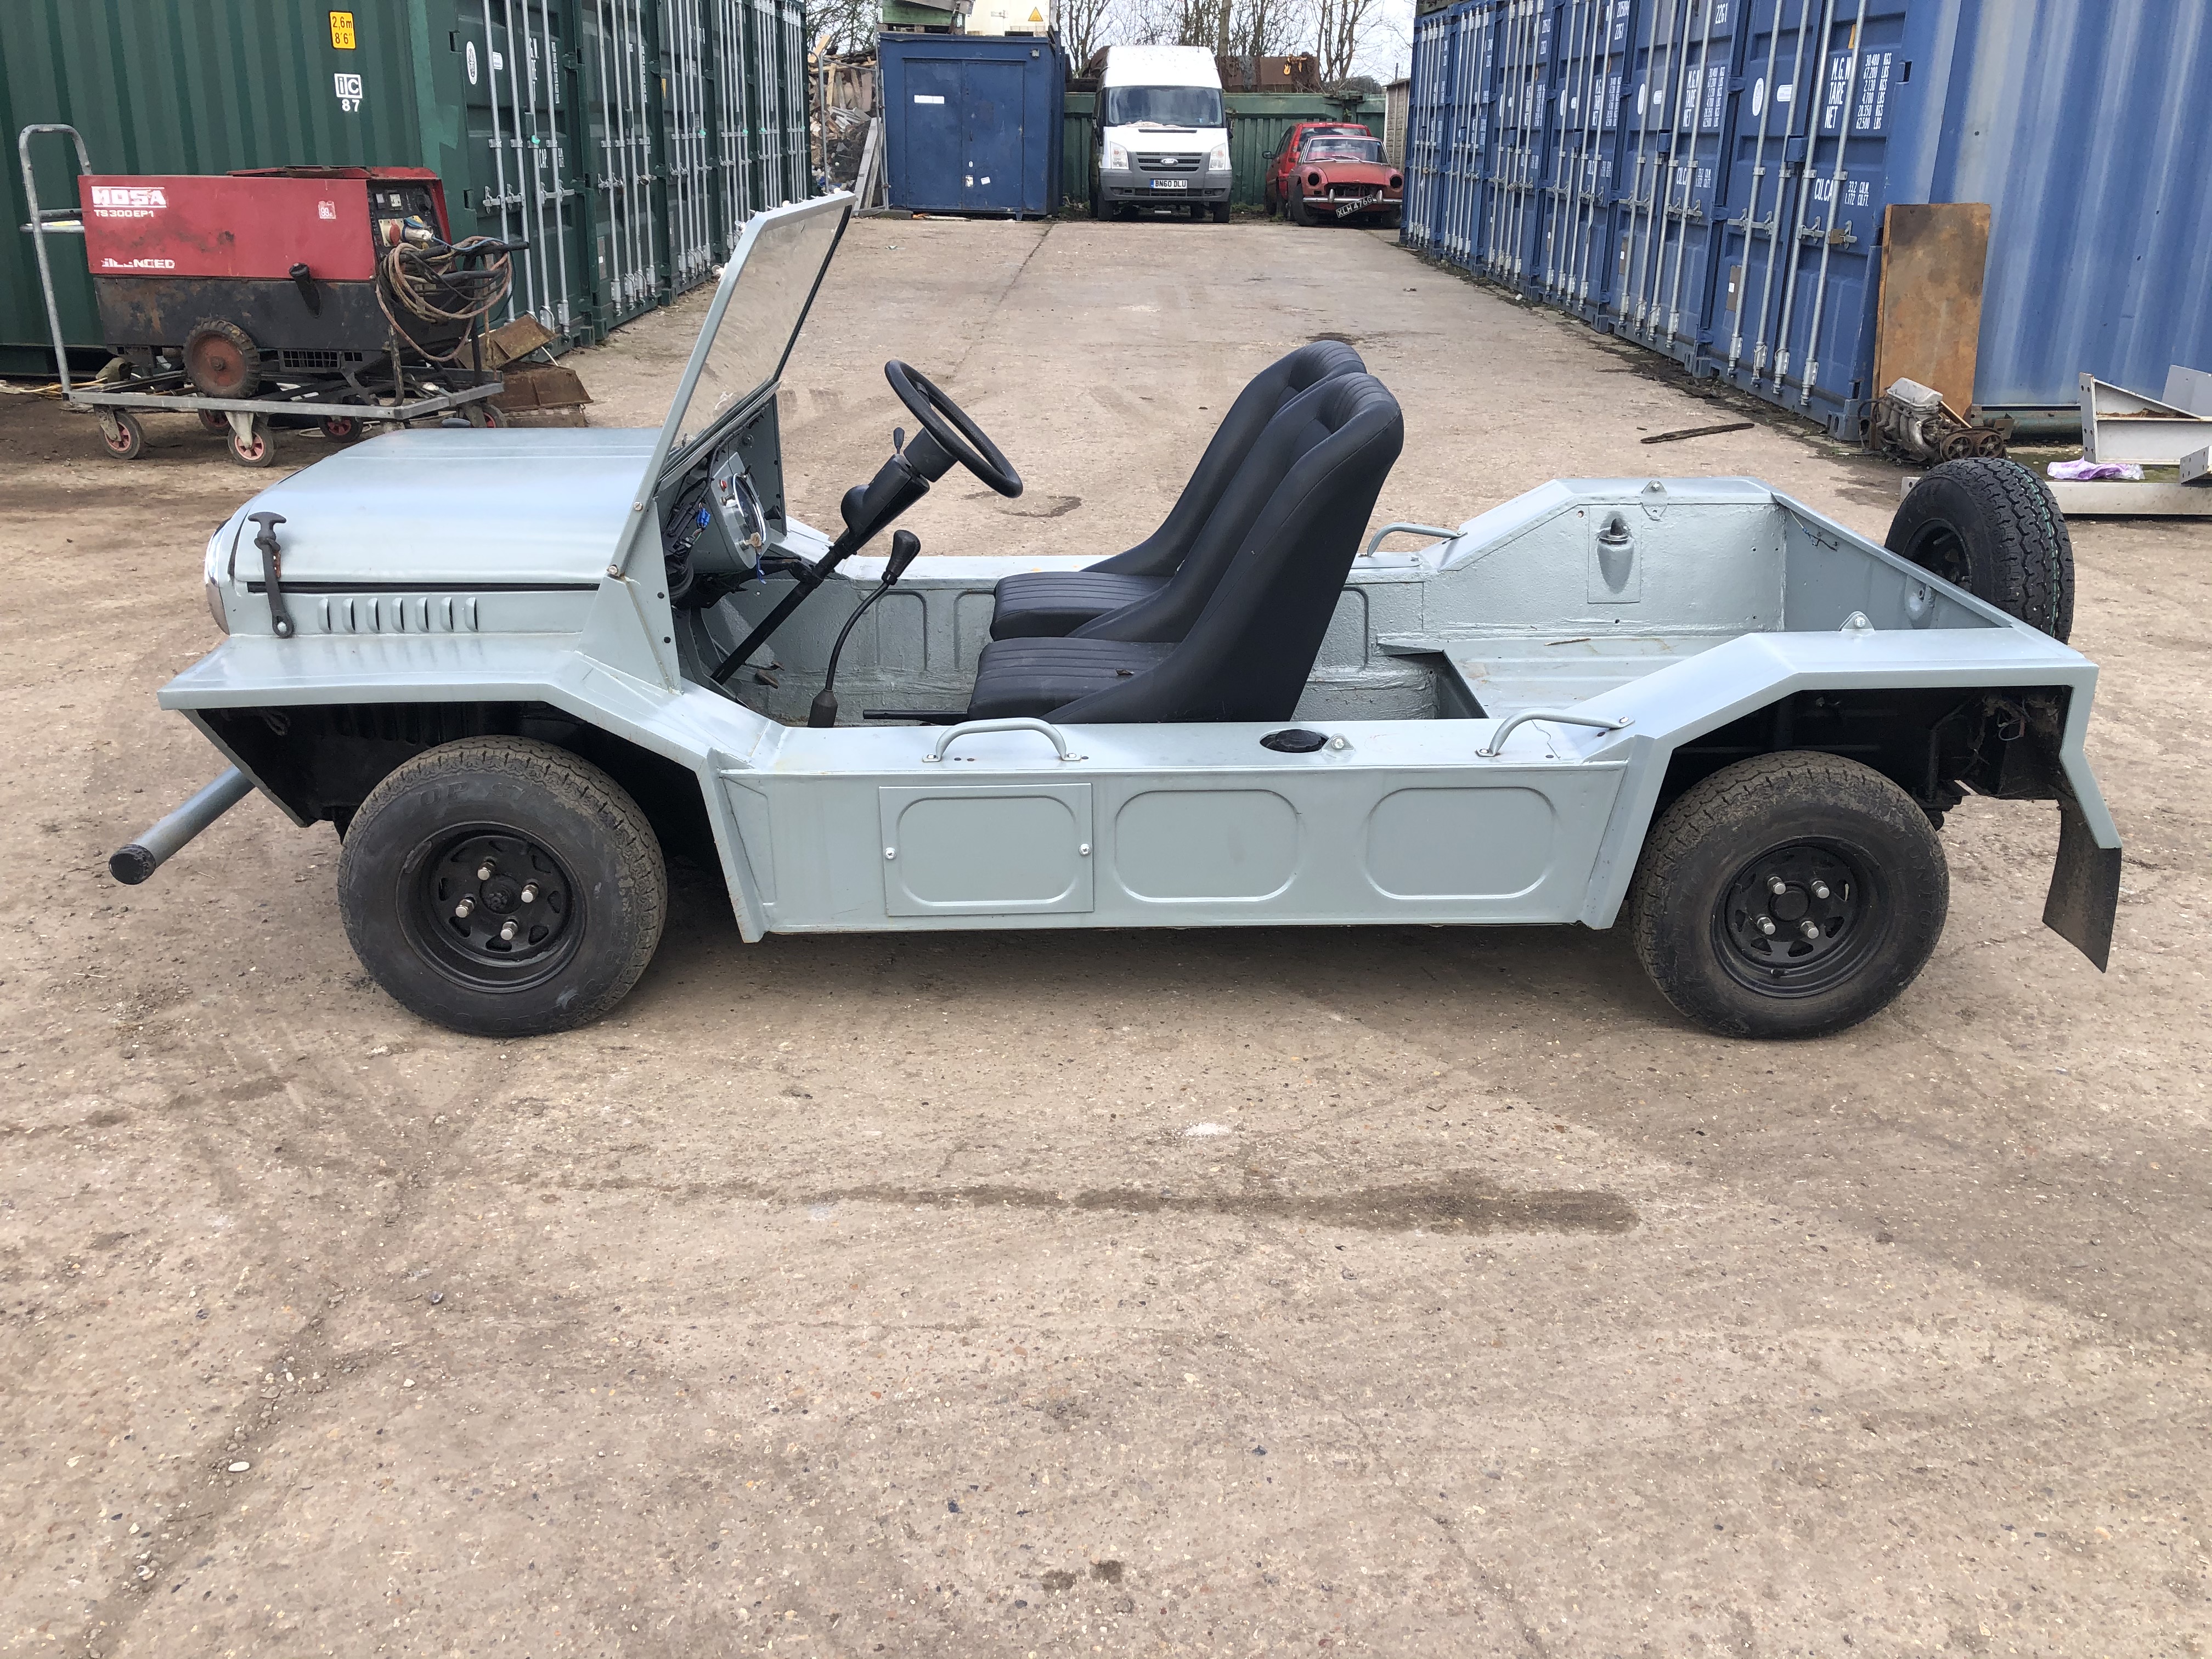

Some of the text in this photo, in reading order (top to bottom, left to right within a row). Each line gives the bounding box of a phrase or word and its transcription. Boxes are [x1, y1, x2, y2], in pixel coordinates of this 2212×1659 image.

[332, 16, 352, 30] 2,6m
[1829, 81, 1846, 104] TARE
[342, 99, 360, 112] 87
[1825, 106, 1838, 128] NET
[1338, 196, 1372, 216] XLH 476G
